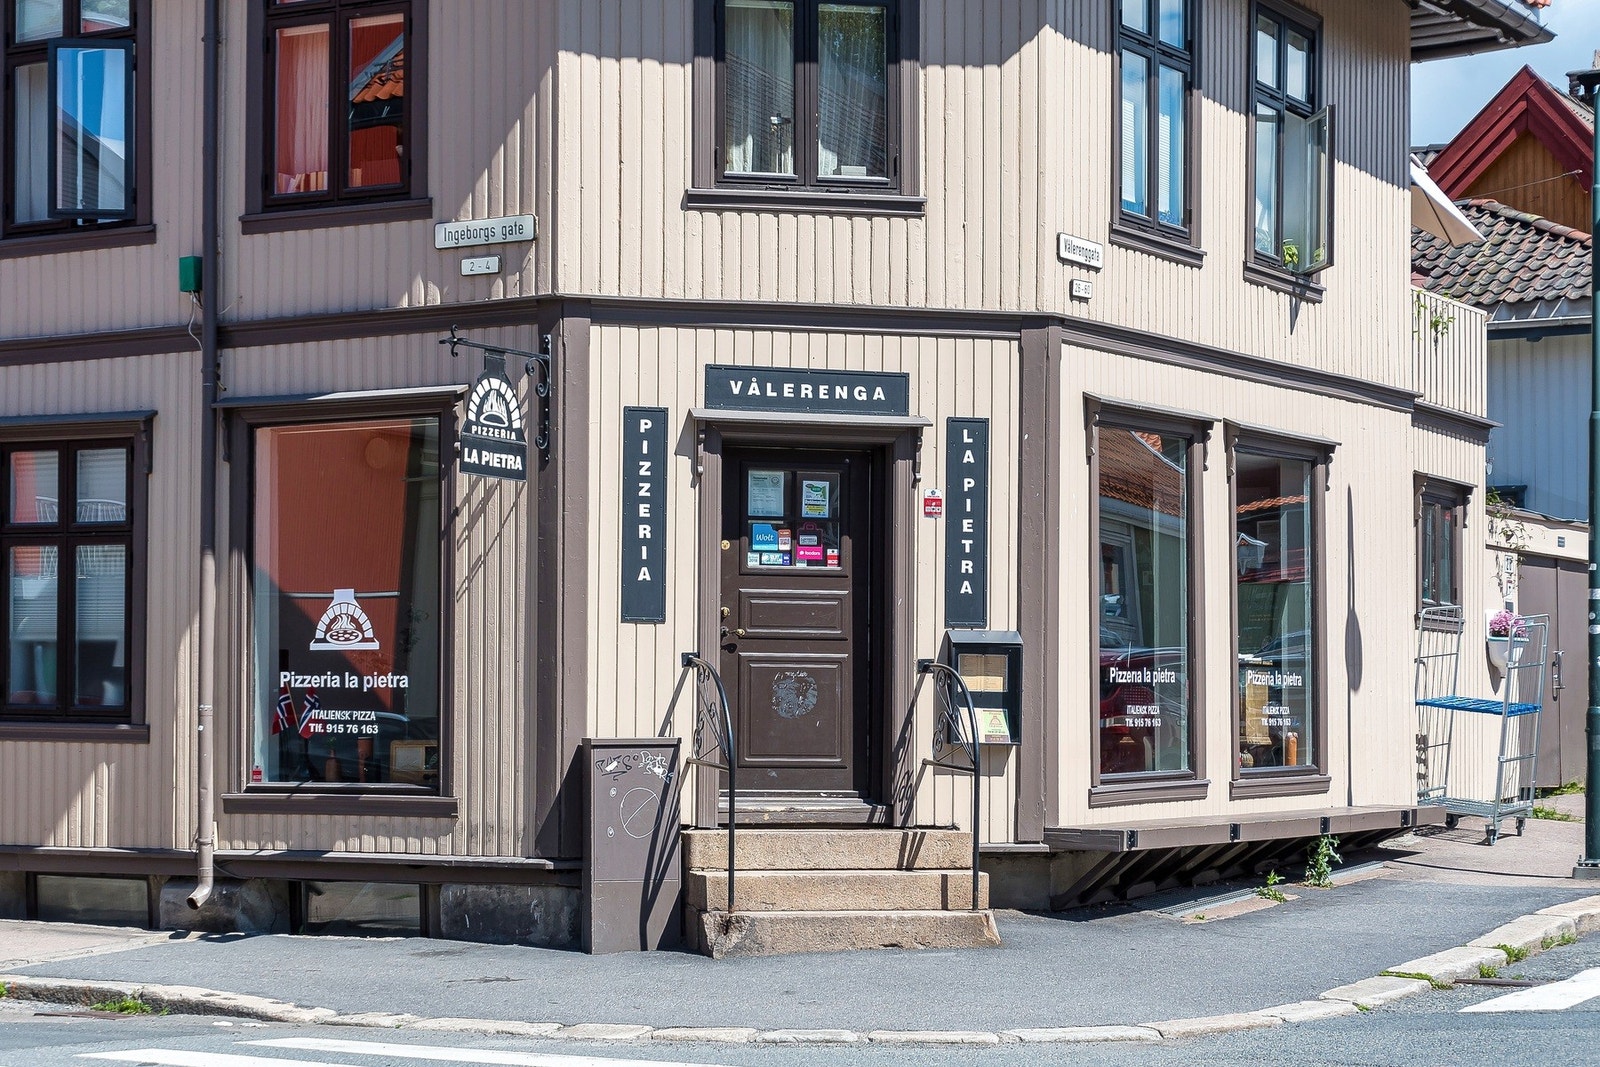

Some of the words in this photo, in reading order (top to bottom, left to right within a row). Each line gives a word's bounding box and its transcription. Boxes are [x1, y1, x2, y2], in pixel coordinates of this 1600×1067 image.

[444, 225, 496, 245] Ingeborgs
[501, 221, 524, 240] gate
[729, 377, 886, 401] VÅLERENGA
[471, 425, 517, 440] PIZZERIA
[963, 429, 975, 464] LA
[463, 447, 479, 464] LA
[481, 450, 523, 471] PIETRA
[637, 419, 653, 581] PIZZERIA
[755, 533, 775, 541] Wolt
[960, 478, 976, 595] PIETRA
[280, 671, 341, 688] Pizzeria
[345, 672, 359, 688] la
[363, 671, 409, 692] pietra
[1109, 667, 1142, 683] Pizzeria
[1143, 667, 1151, 683] la
[1152, 668, 1176, 686] pietra
[1248, 670, 1274, 686] Pizzeria
[1275, 670, 1282, 685] la
[1283, 671, 1302, 689] pietra
[311, 709, 351, 720] ITALIENSK
[353, 711, 376, 720] PIZZA
[1126, 705, 1147, 714] ITALIENSK
[1148, 706, 1160, 714] PIZZA
[309, 723, 325, 733] Tlf.
[326, 724, 344, 733] 915
[346, 724, 359, 733] 76
[361, 725, 379, 734] 163
[1134, 718, 1144, 727] 915
[1144, 718, 1152, 727] 76
[1152, 718, 1162, 727] 163
